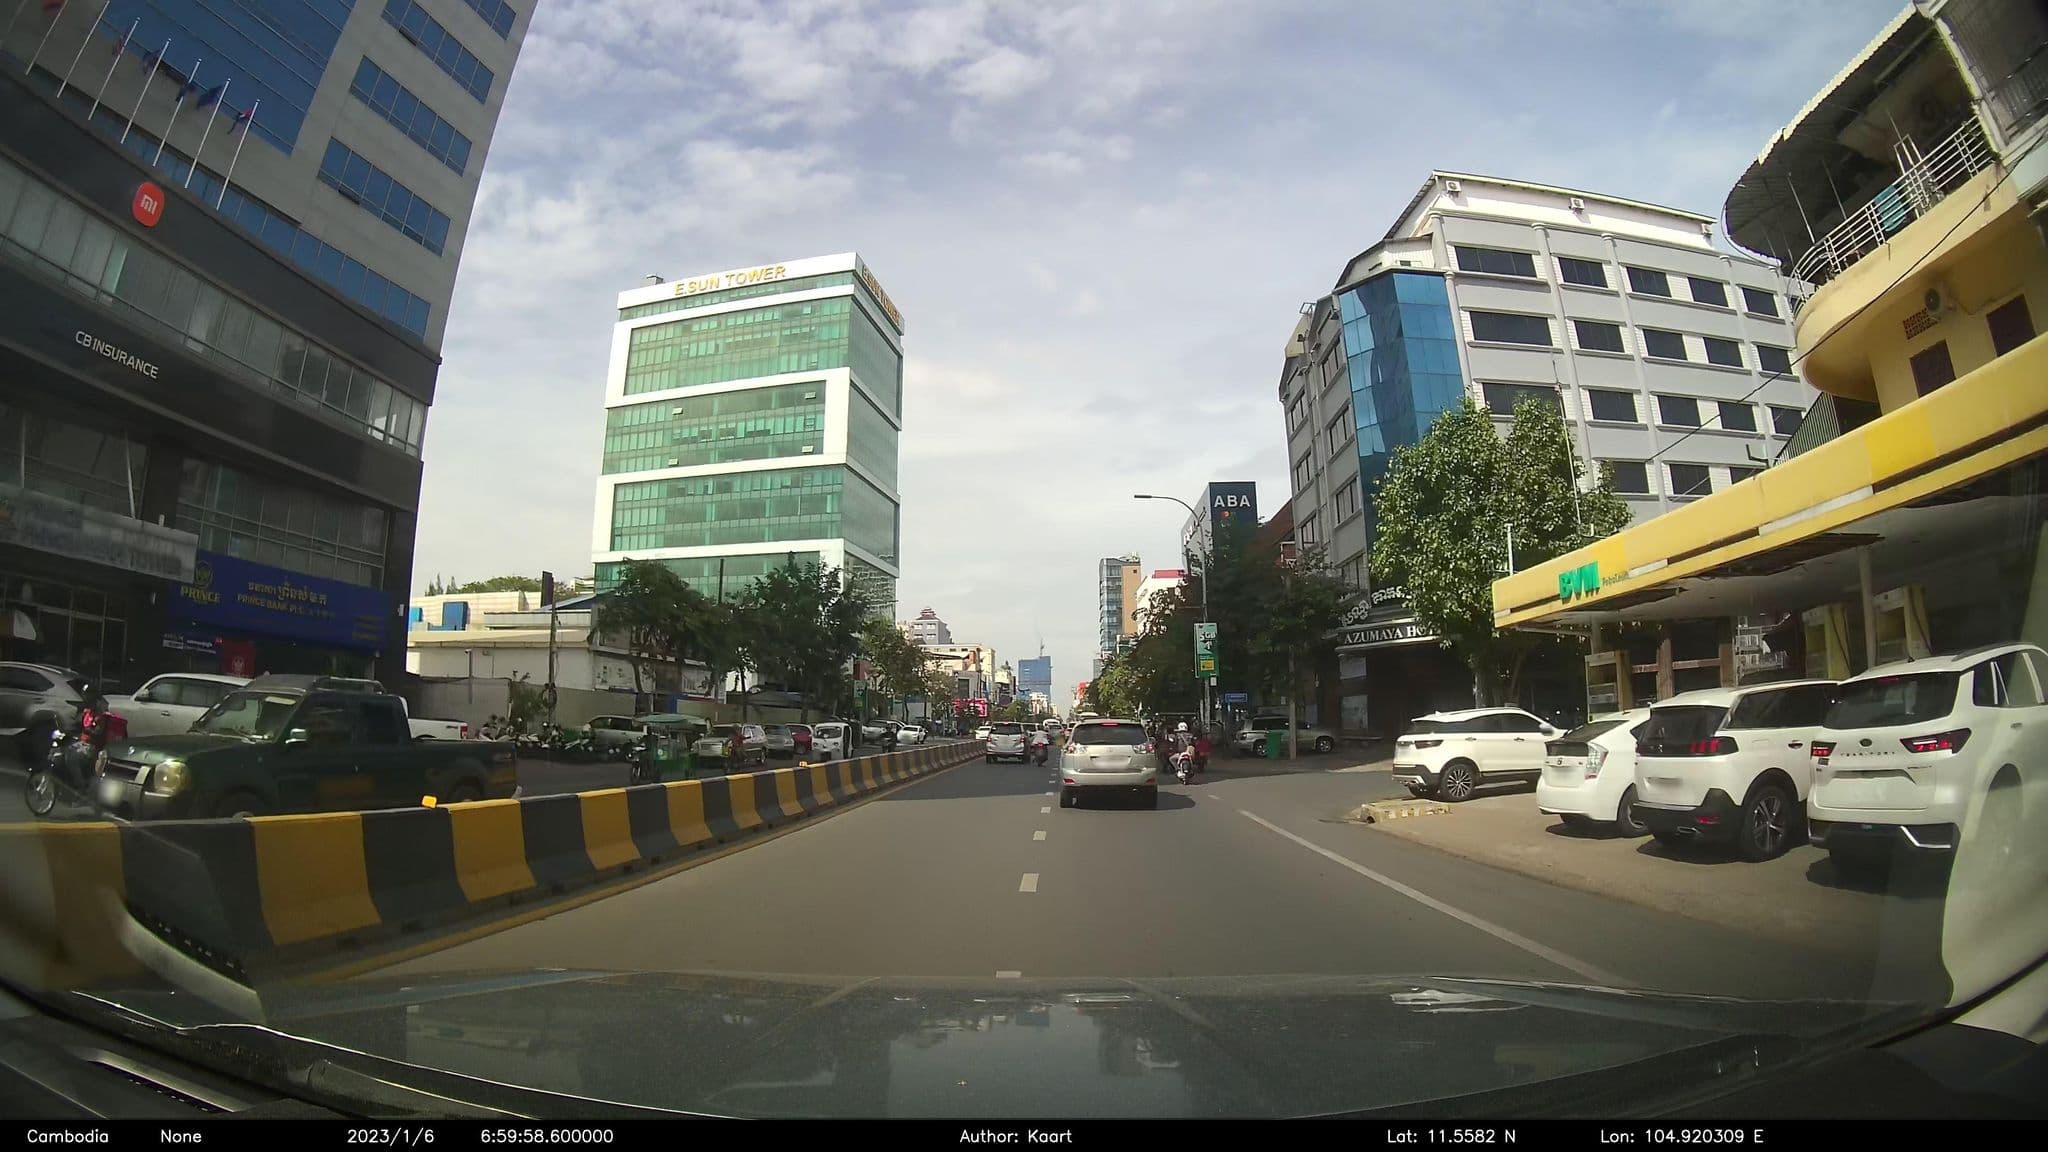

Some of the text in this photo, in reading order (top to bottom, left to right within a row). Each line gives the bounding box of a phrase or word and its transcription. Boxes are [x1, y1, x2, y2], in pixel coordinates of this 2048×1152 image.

[674, 264, 786, 296] E.SUN TOWER
[75, 330, 159, 379] CB INSURANCE
[1213, 494, 1251, 508] ABA
[180, 586, 220, 604] PRINCE
[236, 592, 265, 607] PRINCE
[1344, 627, 1403, 645] AZUMAYA
